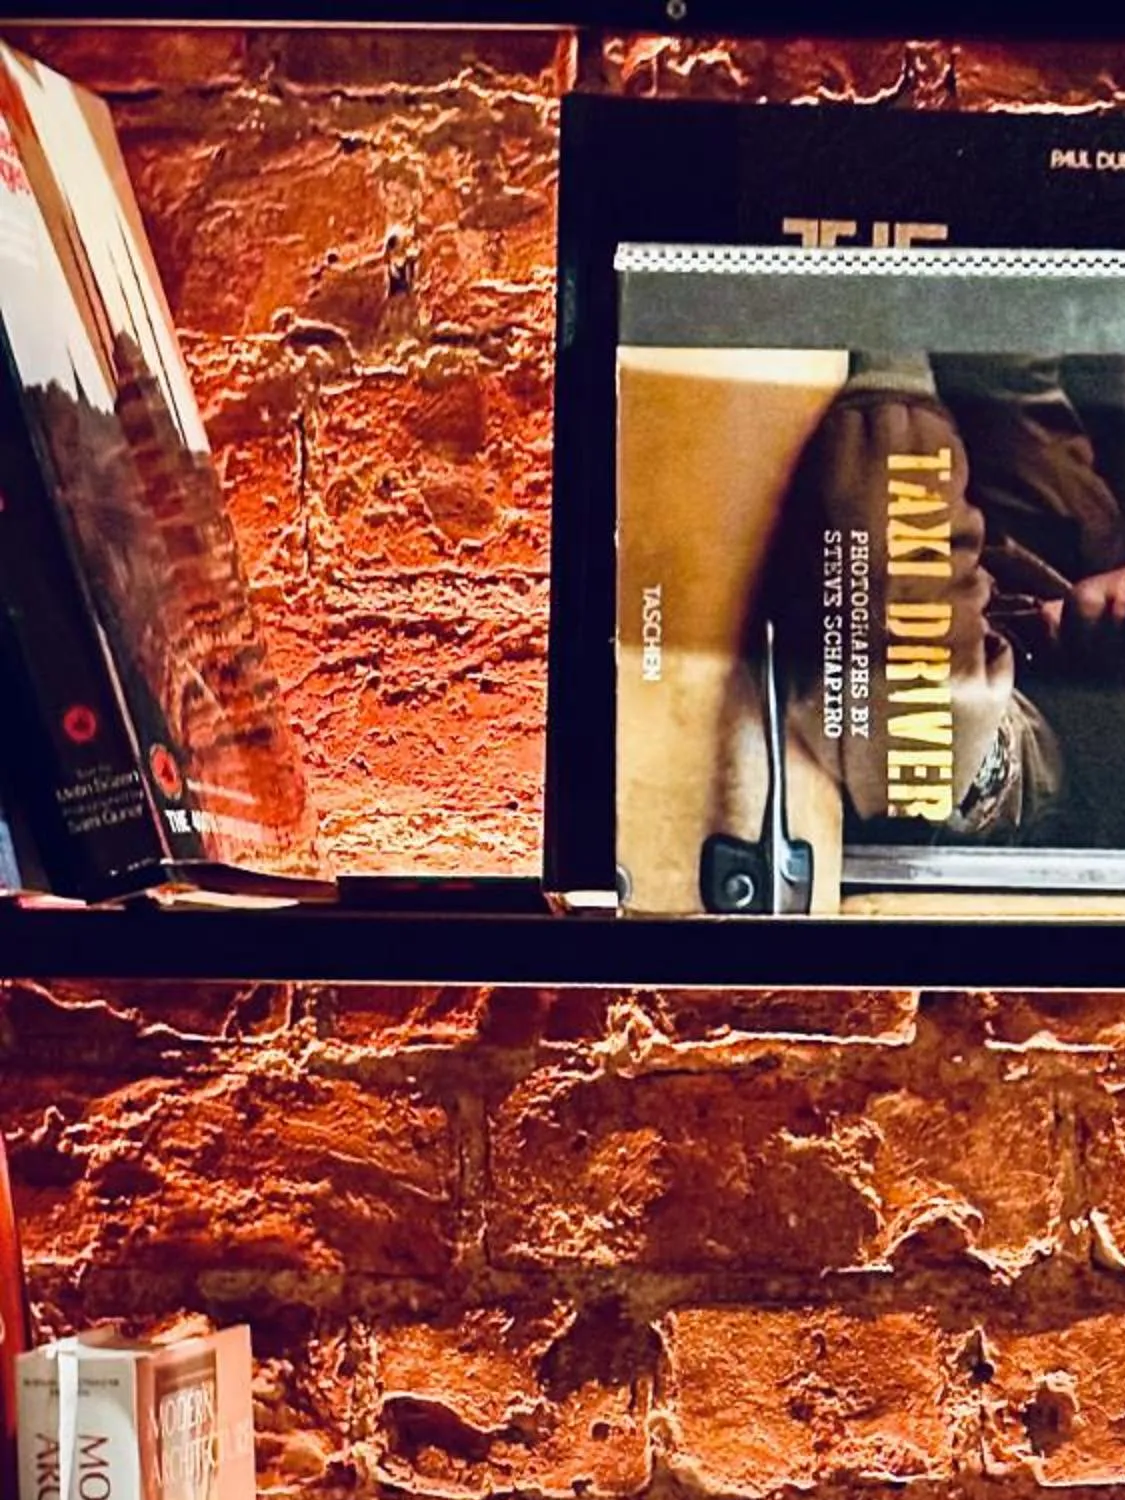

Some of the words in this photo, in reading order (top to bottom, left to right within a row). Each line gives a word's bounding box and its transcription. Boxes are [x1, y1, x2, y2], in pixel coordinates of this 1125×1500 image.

[1050, 149, 1092, 169] PAUL
[823, 529, 843, 608] STEVE
[886, 447, 952, 578] TAXI
[641, 583, 661, 682] TASCHEN
[849, 529, 869, 700] PHOTOGRAPHS
[823, 614, 843, 739] SCHAPIRO
[849, 705, 869, 739] BY
[885, 603, 952, 821] DRIVER
